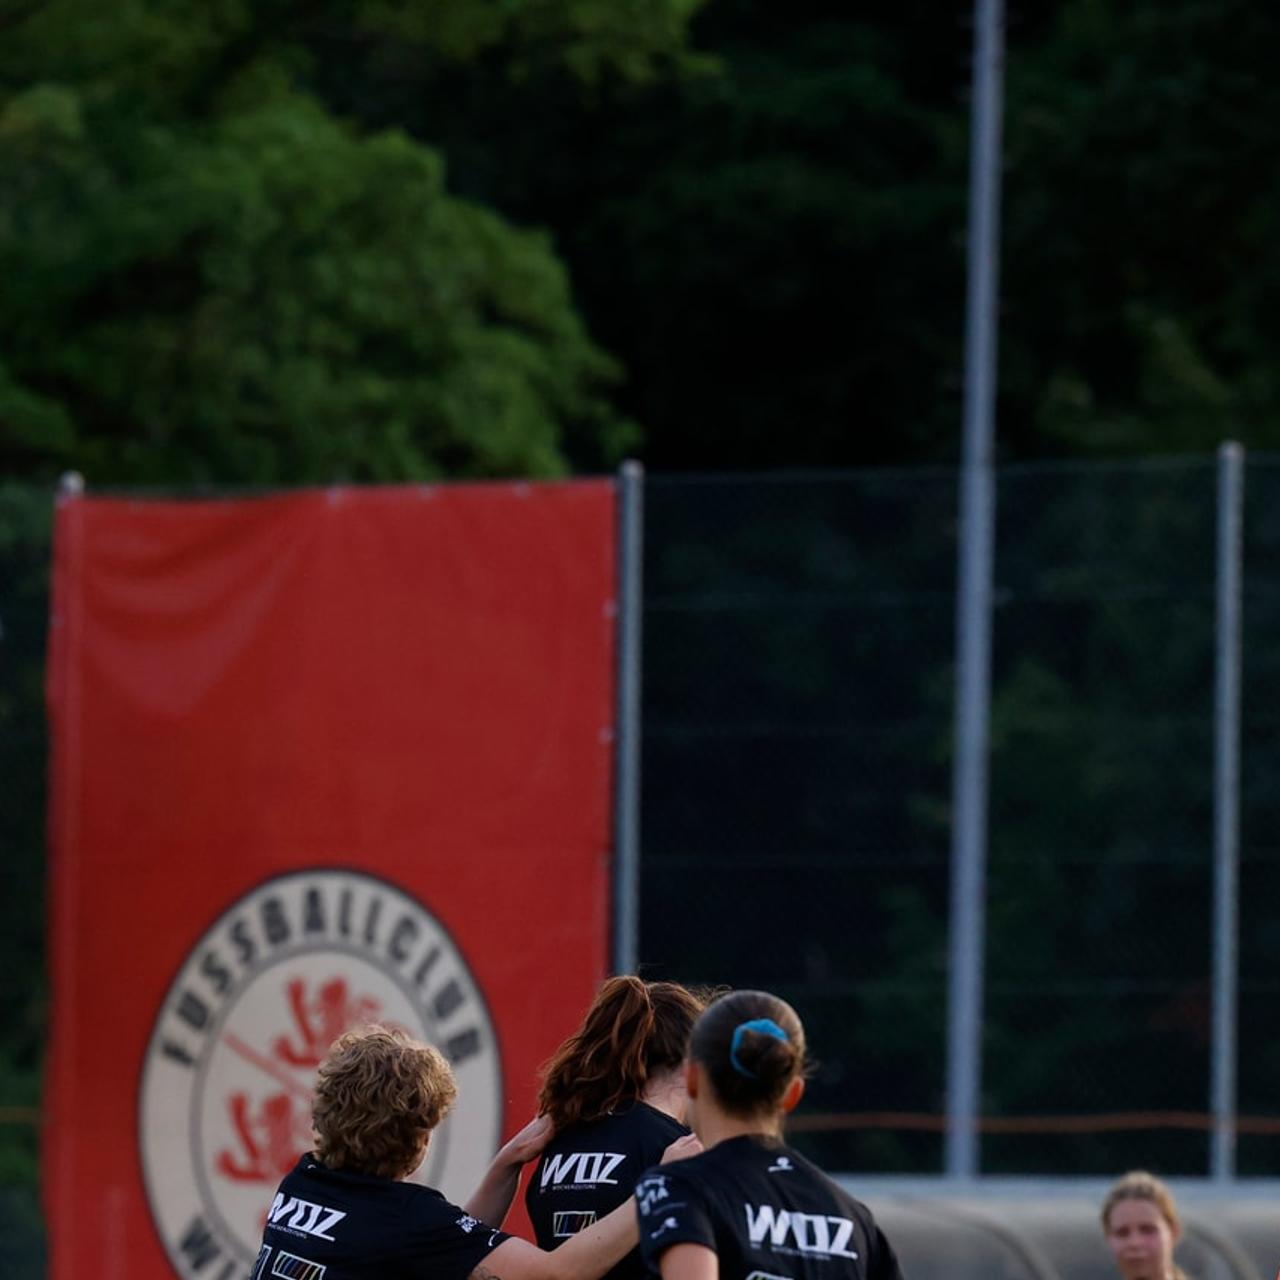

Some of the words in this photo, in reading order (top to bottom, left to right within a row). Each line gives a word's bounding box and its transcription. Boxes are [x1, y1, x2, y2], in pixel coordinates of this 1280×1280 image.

[162, 886, 480, 1069] FUSSBALLCLUB
[540, 1151, 626, 1188] WOZ
[266, 1191, 347, 1242] WOZ
[744, 1202, 858, 1260] WOZ
